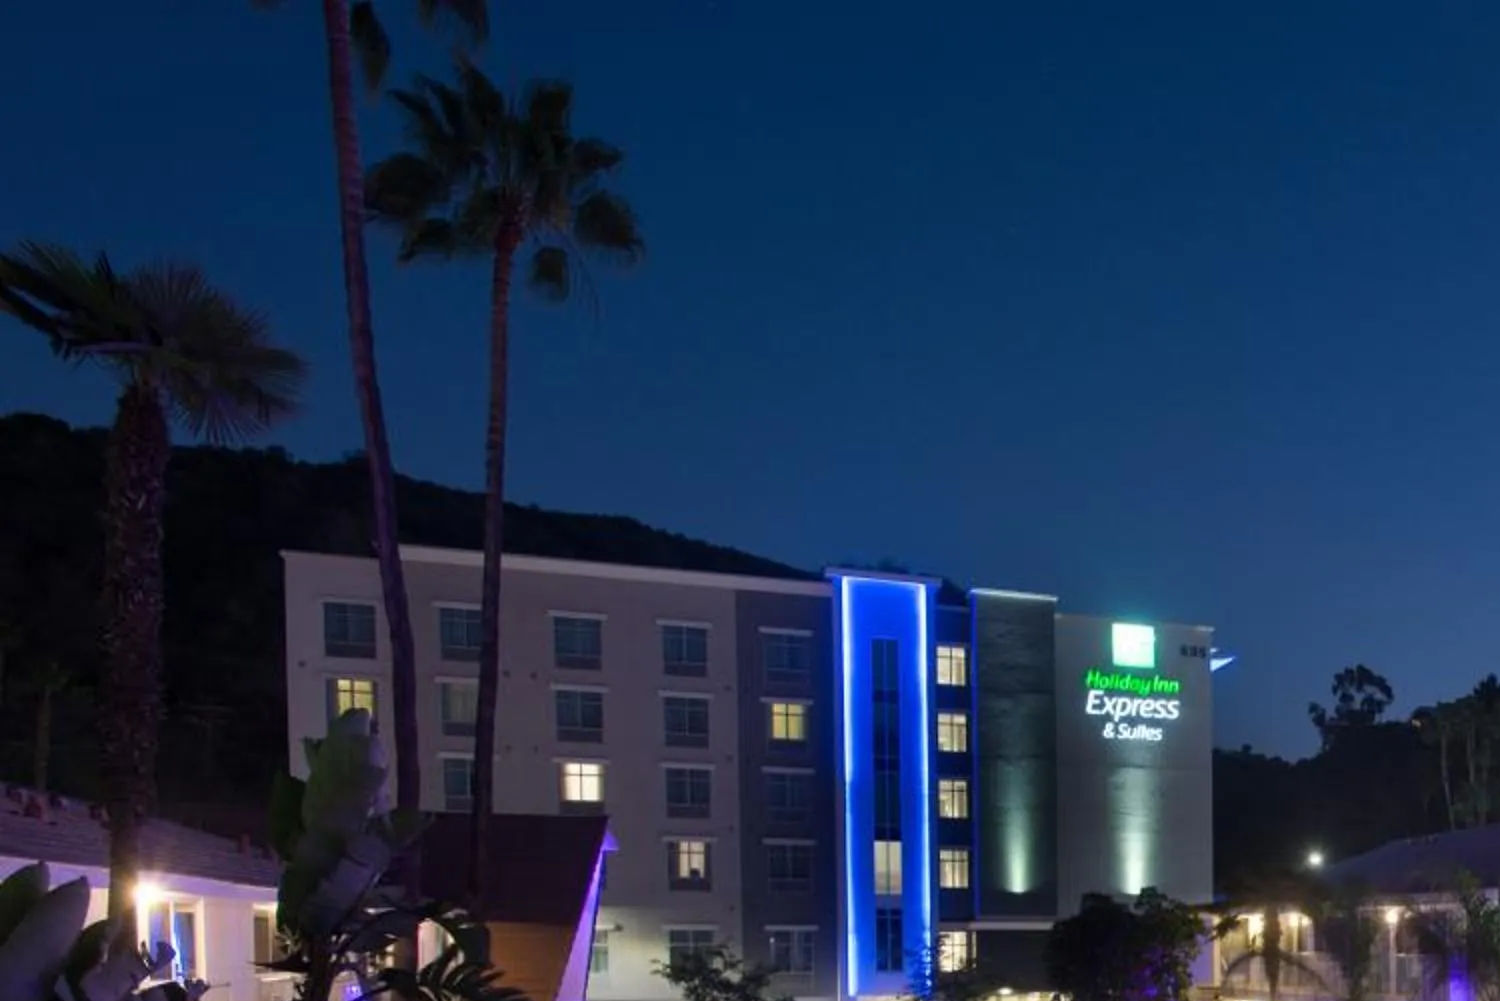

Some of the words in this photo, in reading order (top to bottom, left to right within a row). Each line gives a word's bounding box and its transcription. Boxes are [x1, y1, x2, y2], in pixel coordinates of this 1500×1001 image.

[1086, 669, 1151, 695] Holiday
[1153, 675, 1180, 694] Inn
[1085, 689, 1180, 722] Express
[1103, 723, 1116, 739] &
[1117, 723, 1163, 741] Suites
